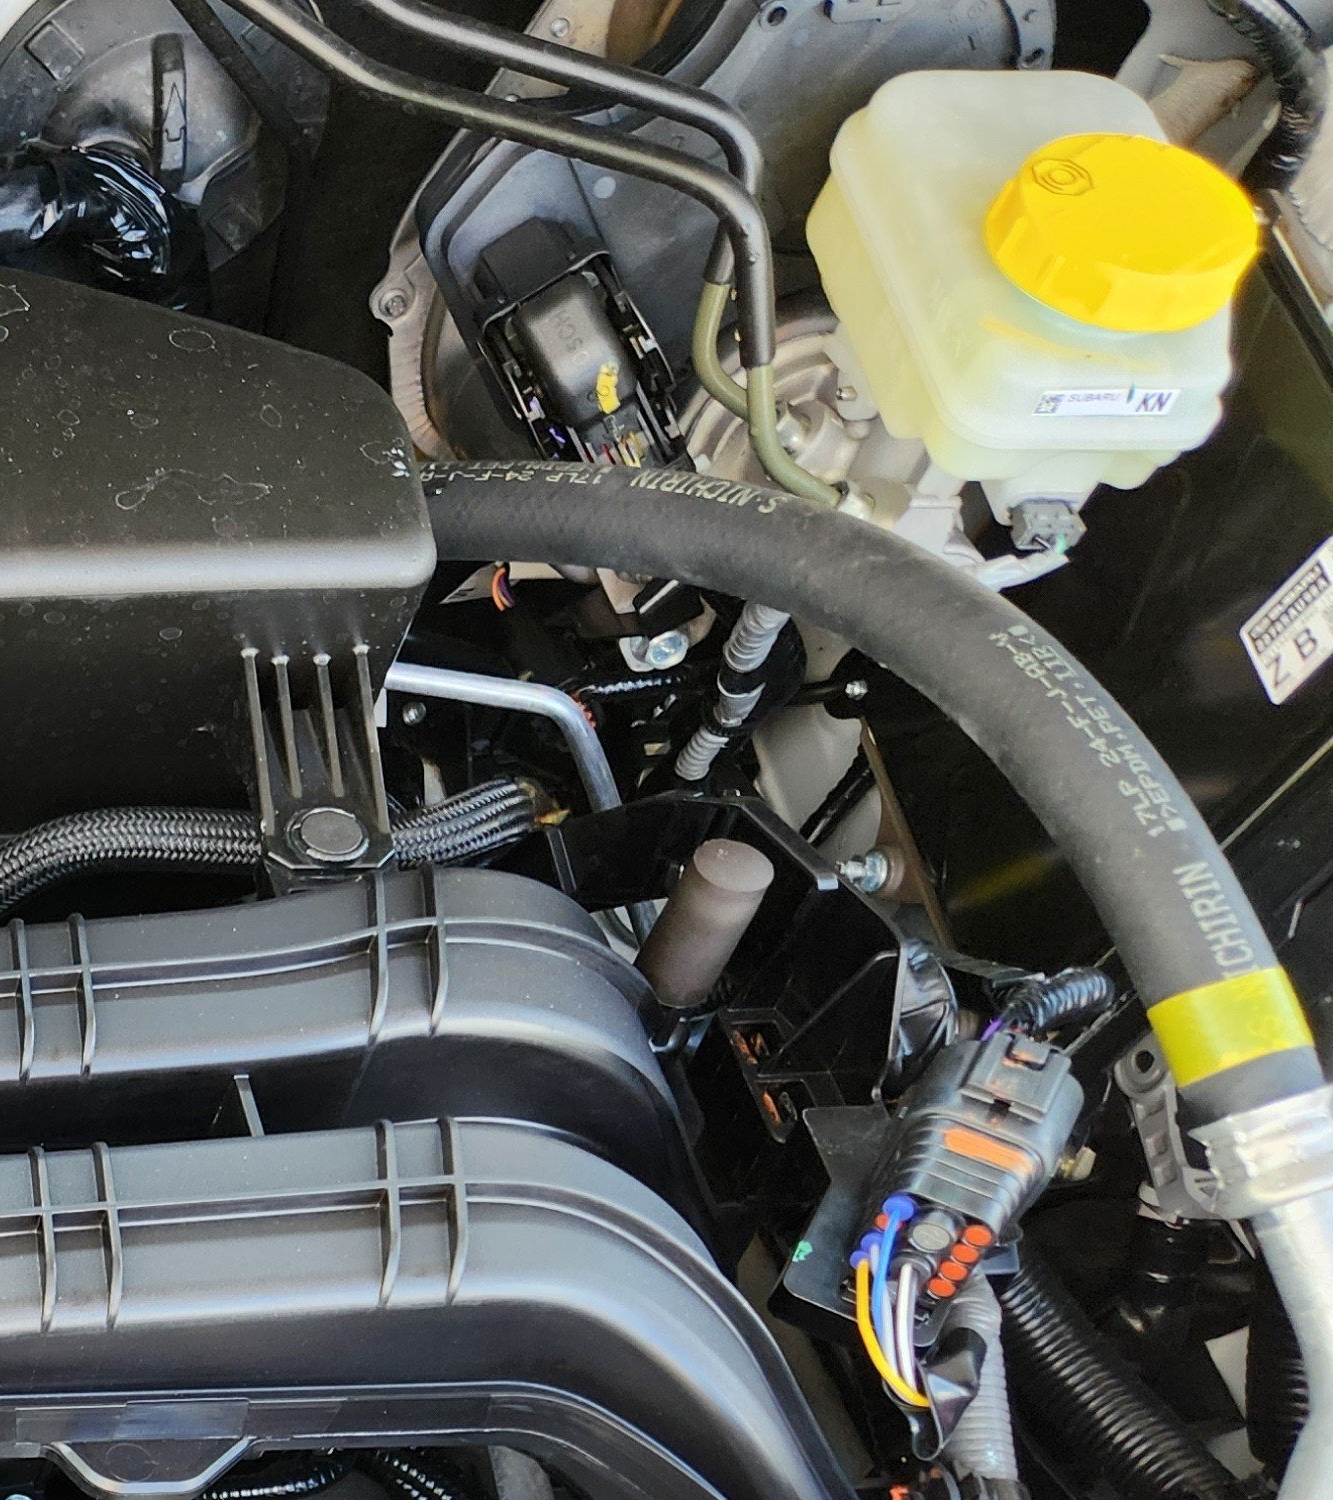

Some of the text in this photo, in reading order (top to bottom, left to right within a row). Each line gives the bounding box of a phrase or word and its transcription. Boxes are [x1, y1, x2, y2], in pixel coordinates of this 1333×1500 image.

[1068, 392, 1172, 412] SUBARU KN
[1294, 628, 1318, 659] B
[1118, 779, 1165, 837] 17LP
